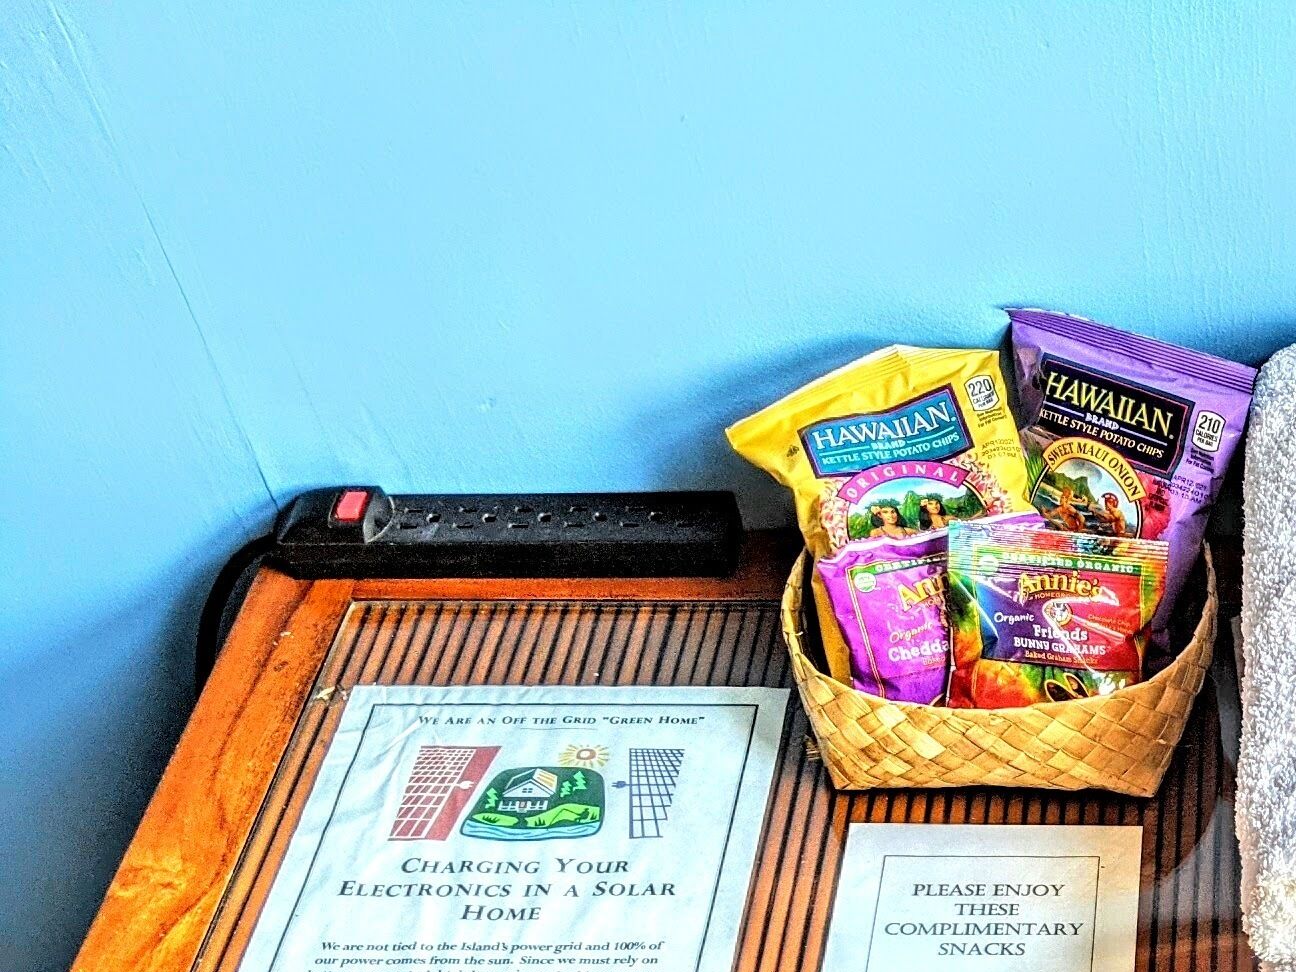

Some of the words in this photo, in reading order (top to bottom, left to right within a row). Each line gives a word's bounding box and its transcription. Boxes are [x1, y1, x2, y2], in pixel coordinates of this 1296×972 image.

[967, 378, 992, 397] 220
[1045, 371, 1174, 437] HAWAIIAN
[812, 401, 951, 450] HAWAIIAN
[1084, 412, 1120, 430] BRAND
[1198, 414, 1221, 434] 210
[1039, 408, 1069, 426] KETTLE
[1069, 419, 1099, 437] STYLE
[1100, 429, 1136, 450] POTATO
[1136, 442, 1165, 459] CHIPS
[1195, 429, 1218, 443] CALORIES
[822, 453, 859, 466] KETTLE
[862, 447, 892, 462] STYLE
[893, 442, 931, 459] POTATO
[932, 432, 960, 449] CHIPS
[870, 439, 906, 452] BRAND
[1048, 442, 1075, 466] SWEET
[1076, 442, 1106, 460] MAUI
[1108, 457, 1141, 498] ONION
[846, 463, 960, 499] ORIGINAL
[1076, 558, 1135, 573] ORGANIC
[897, 572, 947, 611] Ann
[1019, 569, 1101, 600] Annie's
[993, 611, 1035, 626] Organic
[889, 621, 934, 644] Organic
[888, 638, 950, 662] Chedda
[1013, 636, 1050, 651] BUNNY
[1024, 650, 1047, 660] Baked
[400, 857, 541, 875] CHARGING
[555, 857, 630, 875] YOUR
[337, 881, 513, 898] ELECTRONICS
[523, 881, 552, 898] IN
[562, 884, 580, 898] A
[591, 881, 676, 898] SOLAR
[911, 883, 987, 897] PLEASE
[991, 883, 1066, 897] ENJOY
[459, 904, 542, 921] HOME
[954, 903, 1020, 916] THESE
[884, 922, 1084, 936] COMPLIMENTARY
[321, 941, 341, 951] We
[342, 943, 365, 951] are
[365, 943, 389, 951] not
[391, 941, 418, 951] tied
[420, 943, 434, 951] to
[436, 941, 458, 951] the
[460, 941, 509, 951] Island's
[509, 943, 554, 955] power
[553, 941, 583, 955] grid
[584, 941, 611, 951] and
[614, 941, 646, 951] 100%
[648, 940, 666, 951] of
[937, 942, 1026, 956] SNACKS
[314, 957, 339, 965] our
[339, 957, 384, 969] power
[385, 957, 426, 965] comes
[429, 955, 461, 965] from
[464, 955, 486, 965] the
[487, 957, 515, 965] sun.
[518, 955, 556, 965] Since
[557, 957, 577, 965] we
[578, 956, 611, 965] must
[612, 955, 639, 968] rely
[641, 957, 659, 965] on
